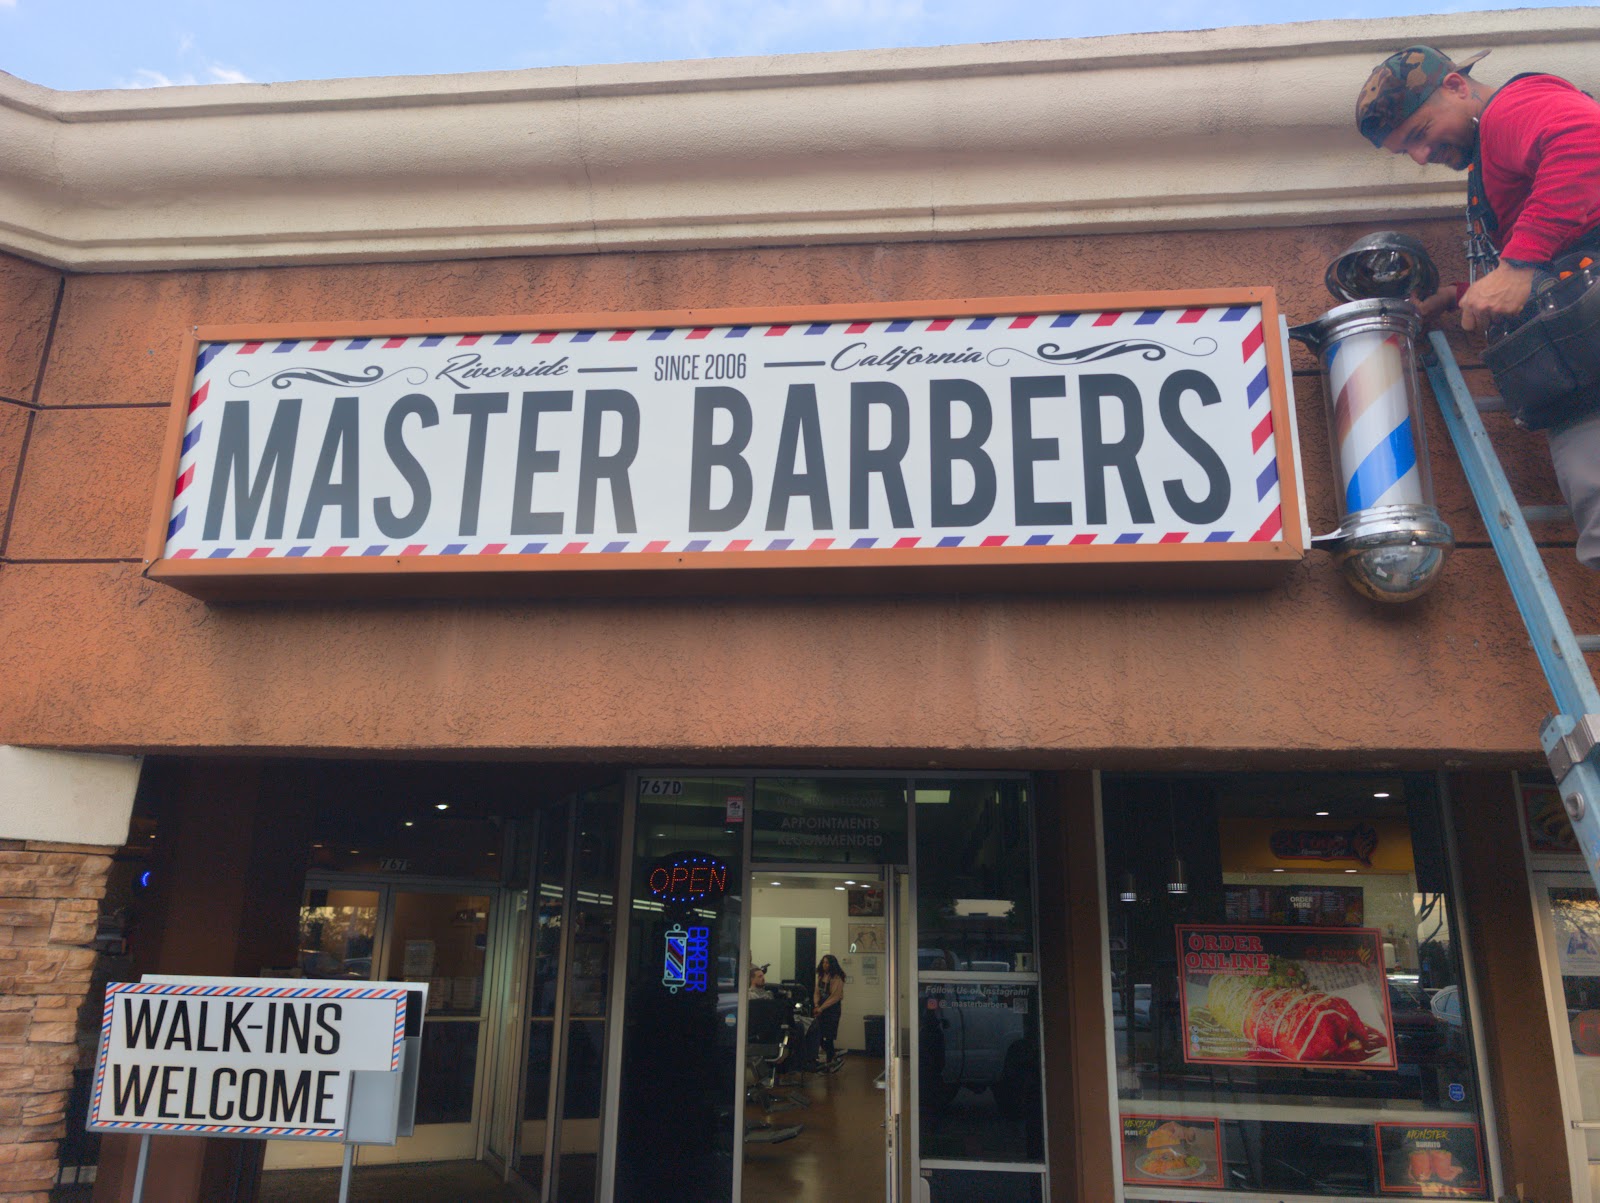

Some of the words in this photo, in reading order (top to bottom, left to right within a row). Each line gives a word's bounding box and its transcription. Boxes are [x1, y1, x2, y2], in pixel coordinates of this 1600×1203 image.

[654, 355, 700, 381] SINCE
[705, 353, 746, 380] 2006
[831, 342, 984, 371] California
[435, 353, 569, 389] Riverside
[202, 388, 640, 541] MASTER
[688, 369, 1231, 533] BARBERS
[641, 780, 681, 794] 767D
[780, 816, 880, 830] APPOINTMENTS
[777, 834, 883, 847] RECOMMENDED
[649, 867, 727, 893] OPEN
[1188, 934, 1263, 951] ORDER
[685, 926, 709, 992] BARBER
[1184, 951, 1270, 969] ONLINE
[925, 985, 955, 994] Follow
[956, 986, 968, 995] Us
[982, 986, 1030, 997] Instagram!
[123, 998, 343, 1055] WALK-INS
[112, 1063, 341, 1125] WELCOME
[1124, 1120, 1157, 1129] MEXICAN
[1406, 1129, 1451, 1140] MONSTER
